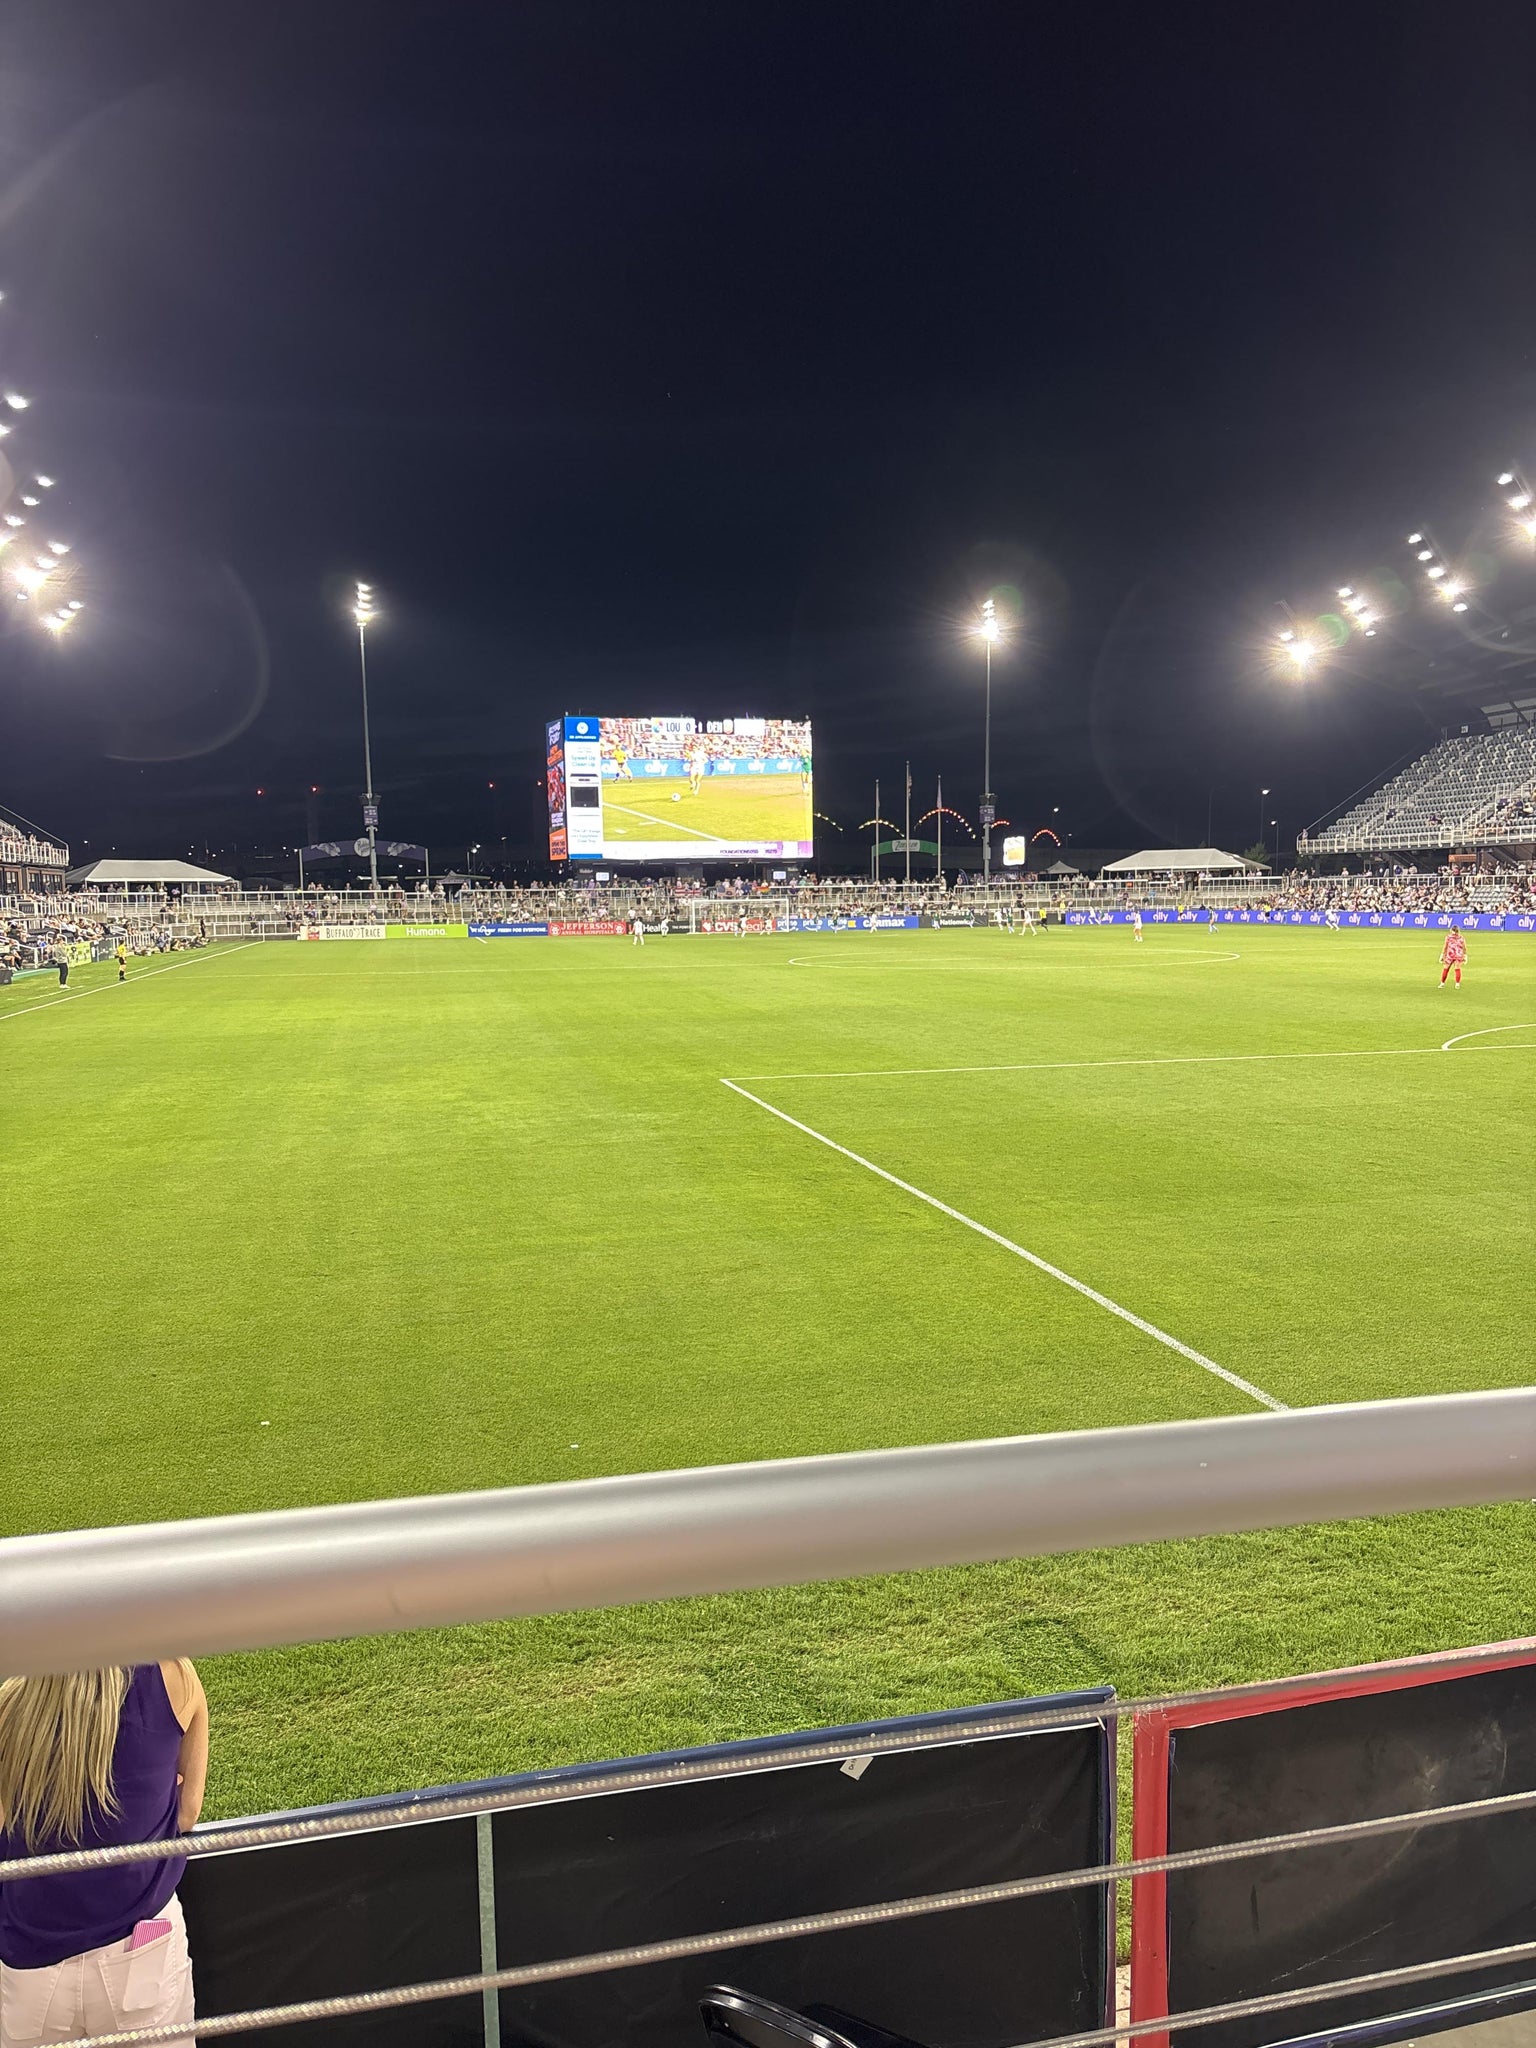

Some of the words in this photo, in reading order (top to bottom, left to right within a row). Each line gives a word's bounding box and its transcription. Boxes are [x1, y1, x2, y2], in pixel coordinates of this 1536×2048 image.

[666, 722, 680, 732] LOU
[686, 722, 690, 732] 0
[707, 721, 722, 733] DEN
[644, 760, 669, 776] ally
[1070, 913, 1086, 924] ally
[1153, 911, 1168, 922] ally
[1181, 911, 1197, 922] ally
[1224, 911, 1235, 922] ally
[1240, 911, 1250, 923] ally
[1274, 912, 1284, 923] ally
[1291, 912, 1302, 924] ally
[1310, 912, 1321, 924] ally
[1349, 913, 1361, 925] ally
[1370, 913, 1382, 926] ally
[1391, 914, 1405, 927] ally
[1414, 914, 1428, 927] ally
[1438, 914, 1452, 928] ally
[1463, 915, 1479, 929] ally
[561, 922, 614, 930] JEFFERSON
[715, 921, 738, 932] CVS
[1518, 916, 1534, 930] ally
[326, 927, 354, 939] BUFFALO
[361, 927, 381, 938] TRACE
[478, 925, 496, 936] Kroger
